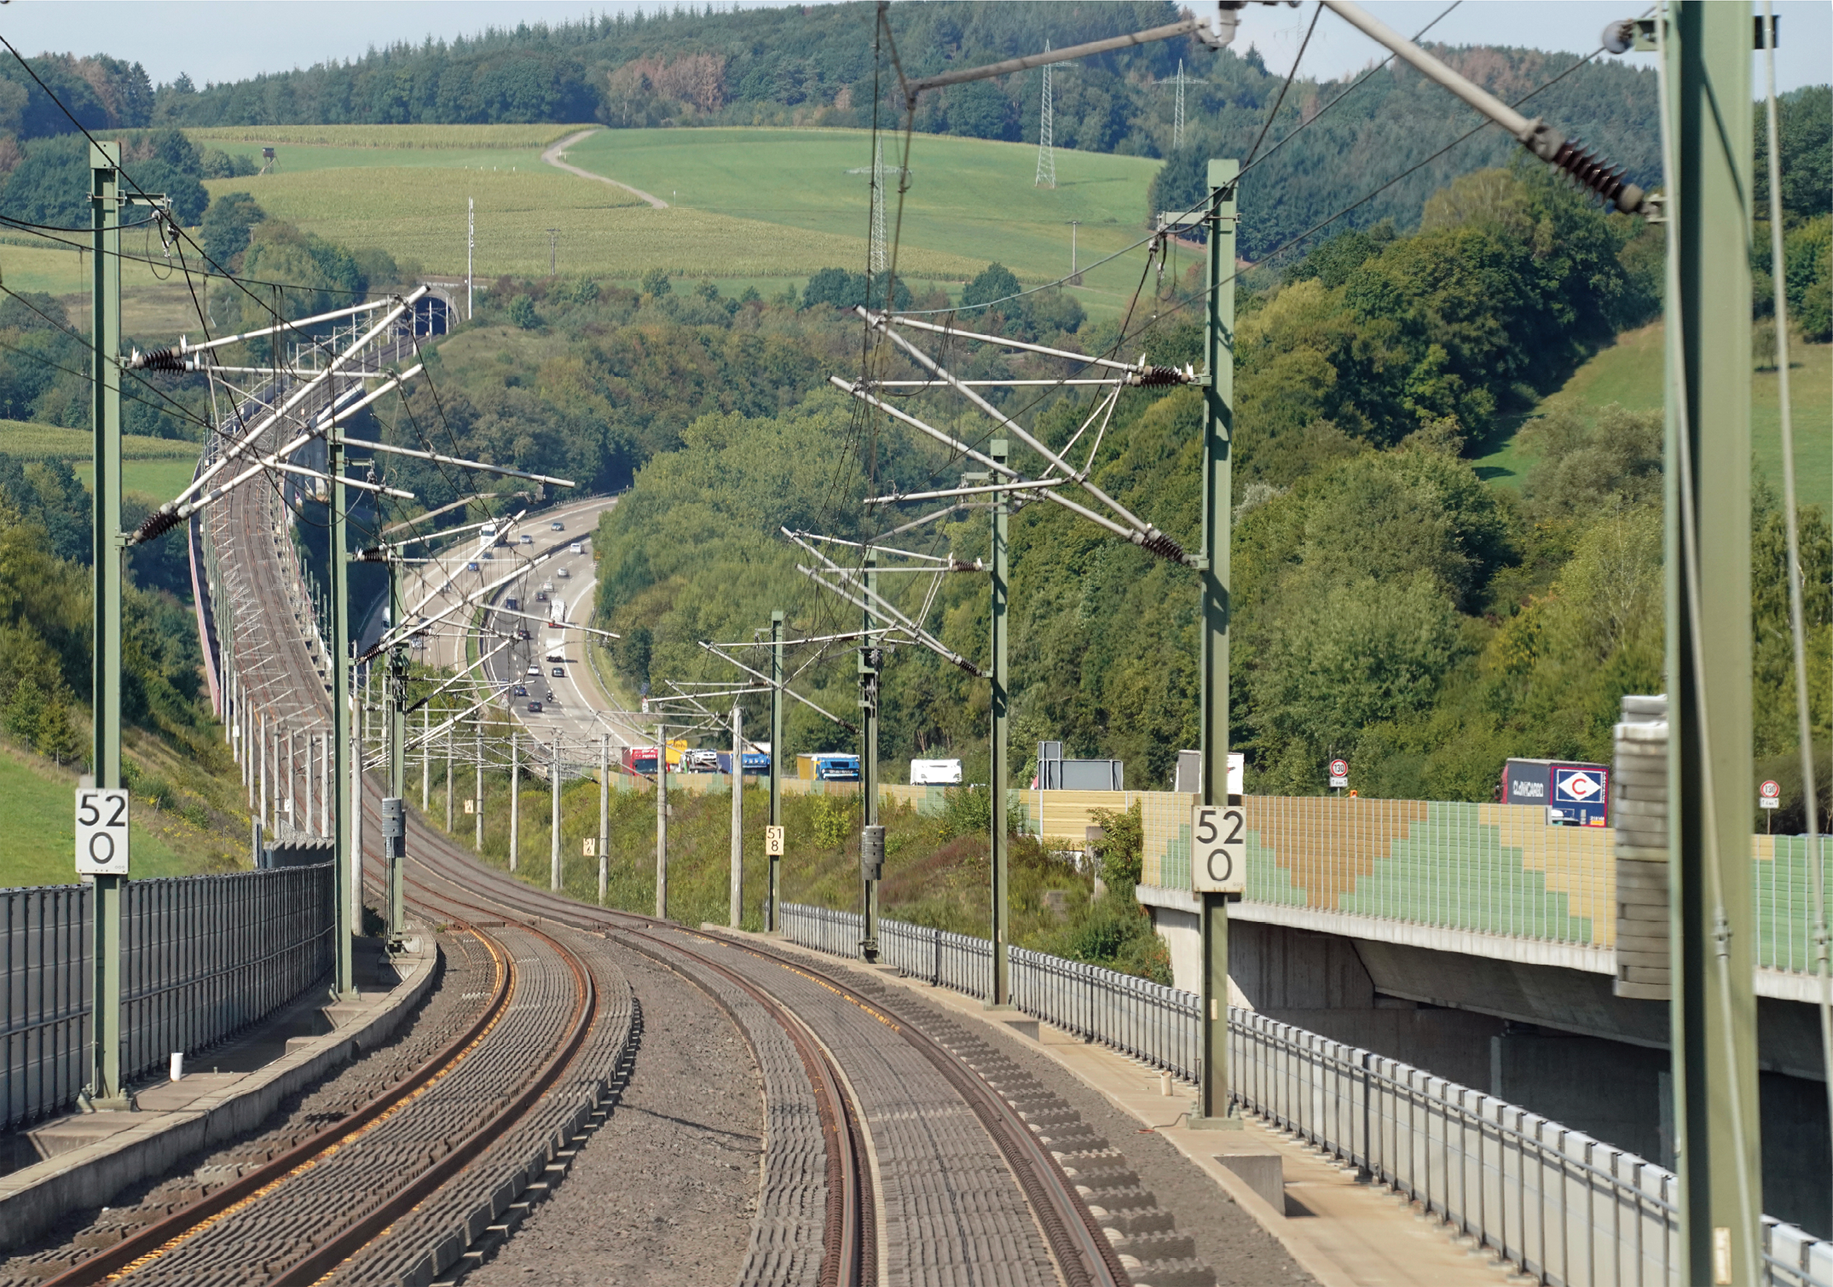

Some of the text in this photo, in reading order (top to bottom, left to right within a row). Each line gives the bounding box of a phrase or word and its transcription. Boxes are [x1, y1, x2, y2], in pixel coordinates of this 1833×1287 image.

[1334, 764, 1344, 772] 130
[1571, 778, 1587, 795] C
[78, 794, 125, 827] 52
[767, 827, 782, 839] 51
[1196, 810, 1244, 844] 52
[89, 831, 115, 864] 0
[586, 846, 592, 854] 6
[771, 839, 779, 852] 8
[1207, 848, 1233, 881] 0
